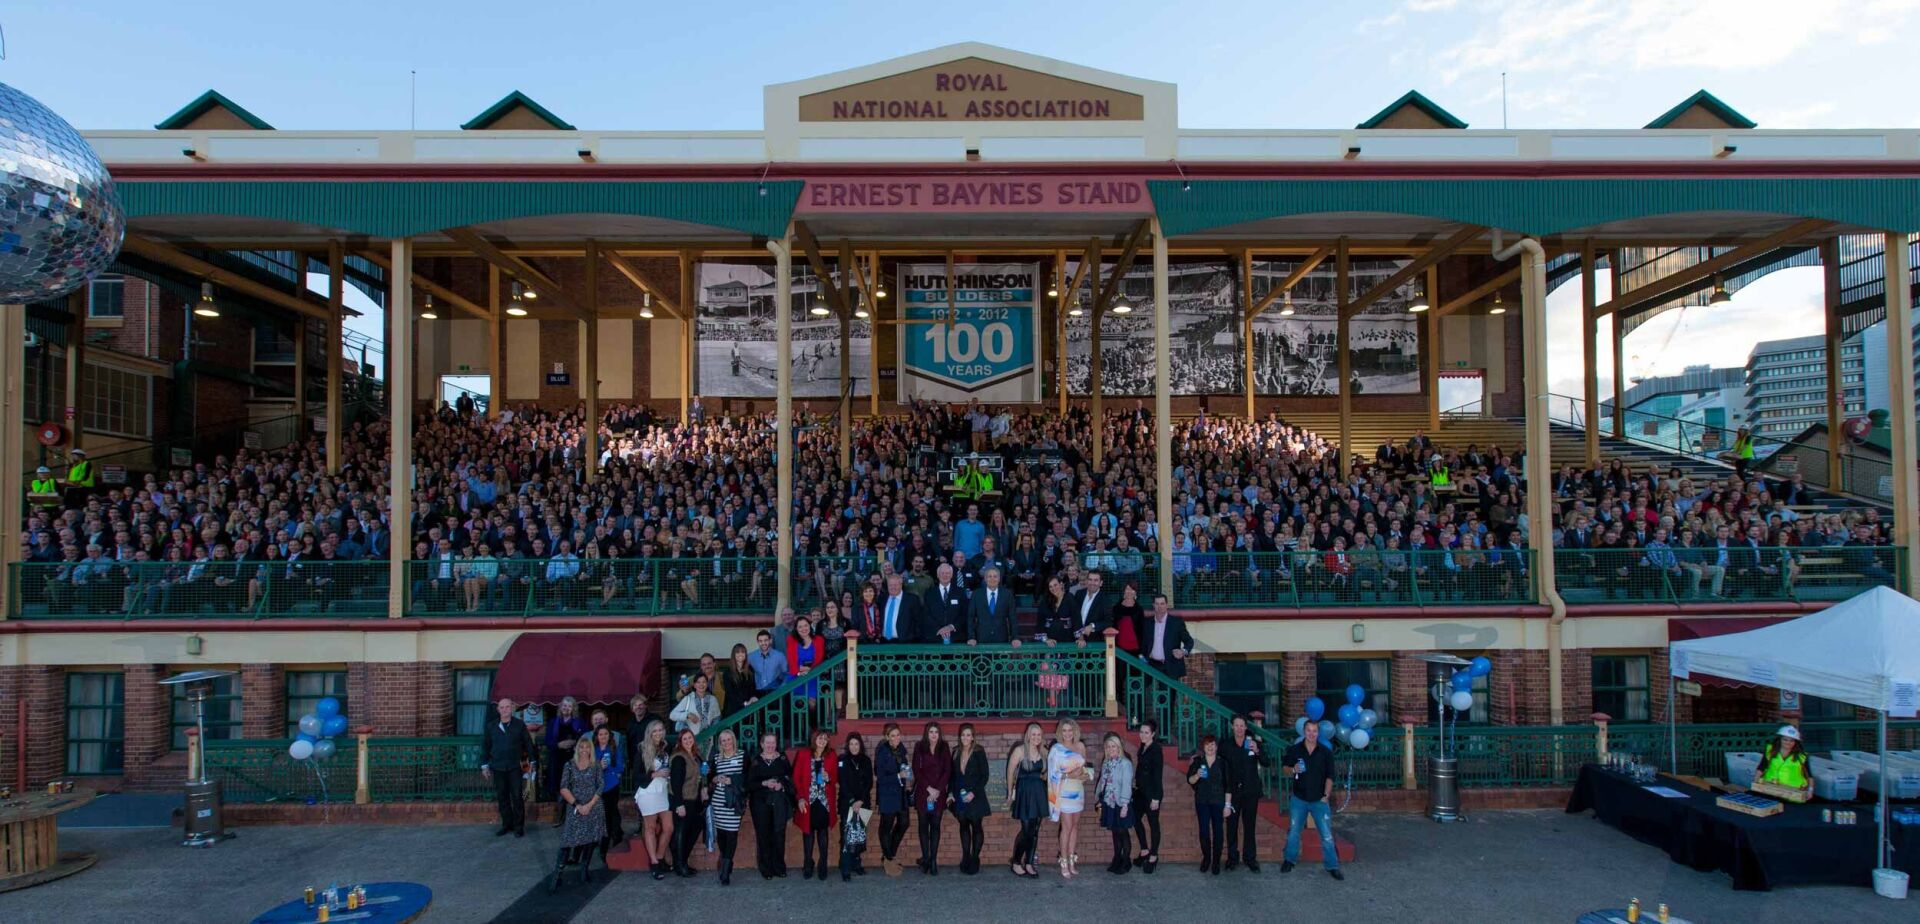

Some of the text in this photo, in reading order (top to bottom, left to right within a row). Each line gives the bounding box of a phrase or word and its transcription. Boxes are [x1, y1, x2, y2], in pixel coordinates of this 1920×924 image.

[936, 73, 1008, 92] ROYAL
[833, 100, 1110, 119] NATIONAL ASSOCIATION
[810, 182, 1142, 206] ERNEST BAYNES STAND
[925, 291, 1013, 301] BULDERS
[978, 308, 1009, 320] 2012
[925, 322, 1014, 363] 100
[947, 364, 992, 376] YEARS
